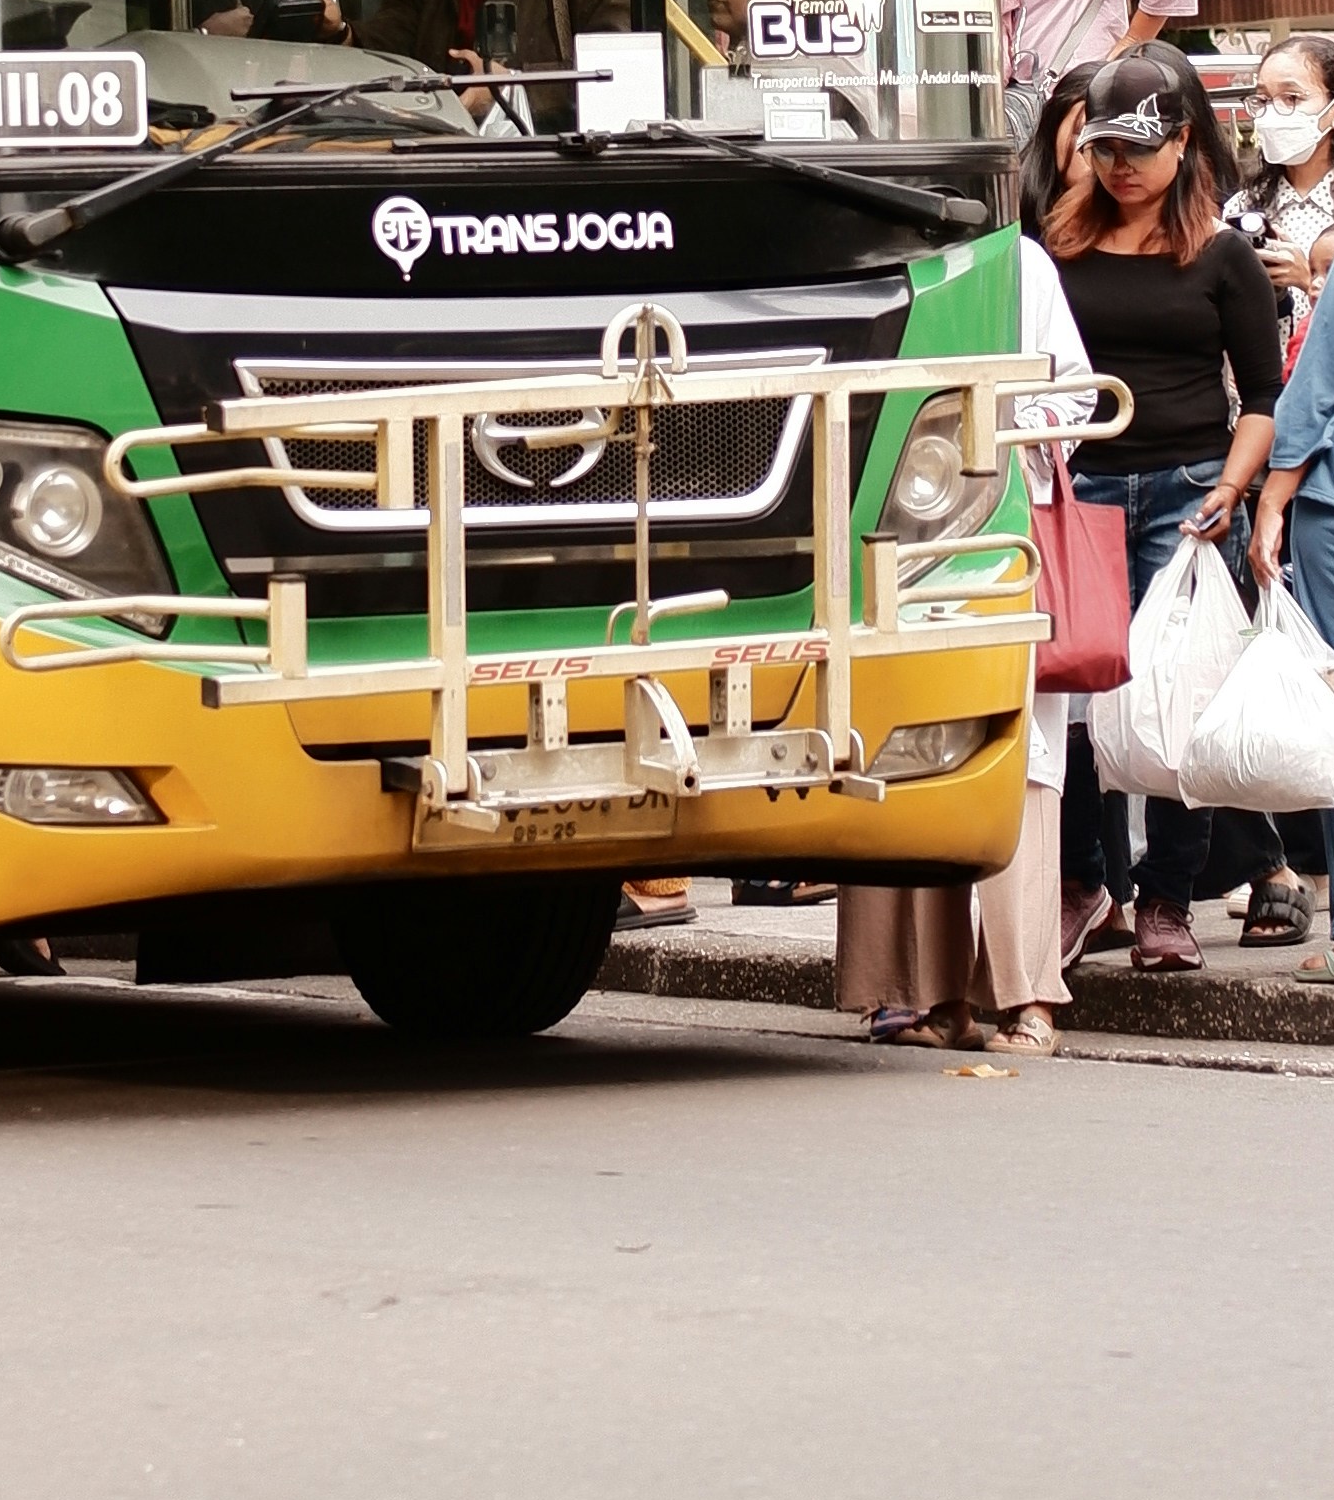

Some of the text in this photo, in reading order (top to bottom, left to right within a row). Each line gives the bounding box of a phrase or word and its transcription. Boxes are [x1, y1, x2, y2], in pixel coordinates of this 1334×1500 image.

[751, 71, 823, 92] Transportasi
[711, 639, 831, 668] SELIS
[470, 656, 593, 682] SELIS
